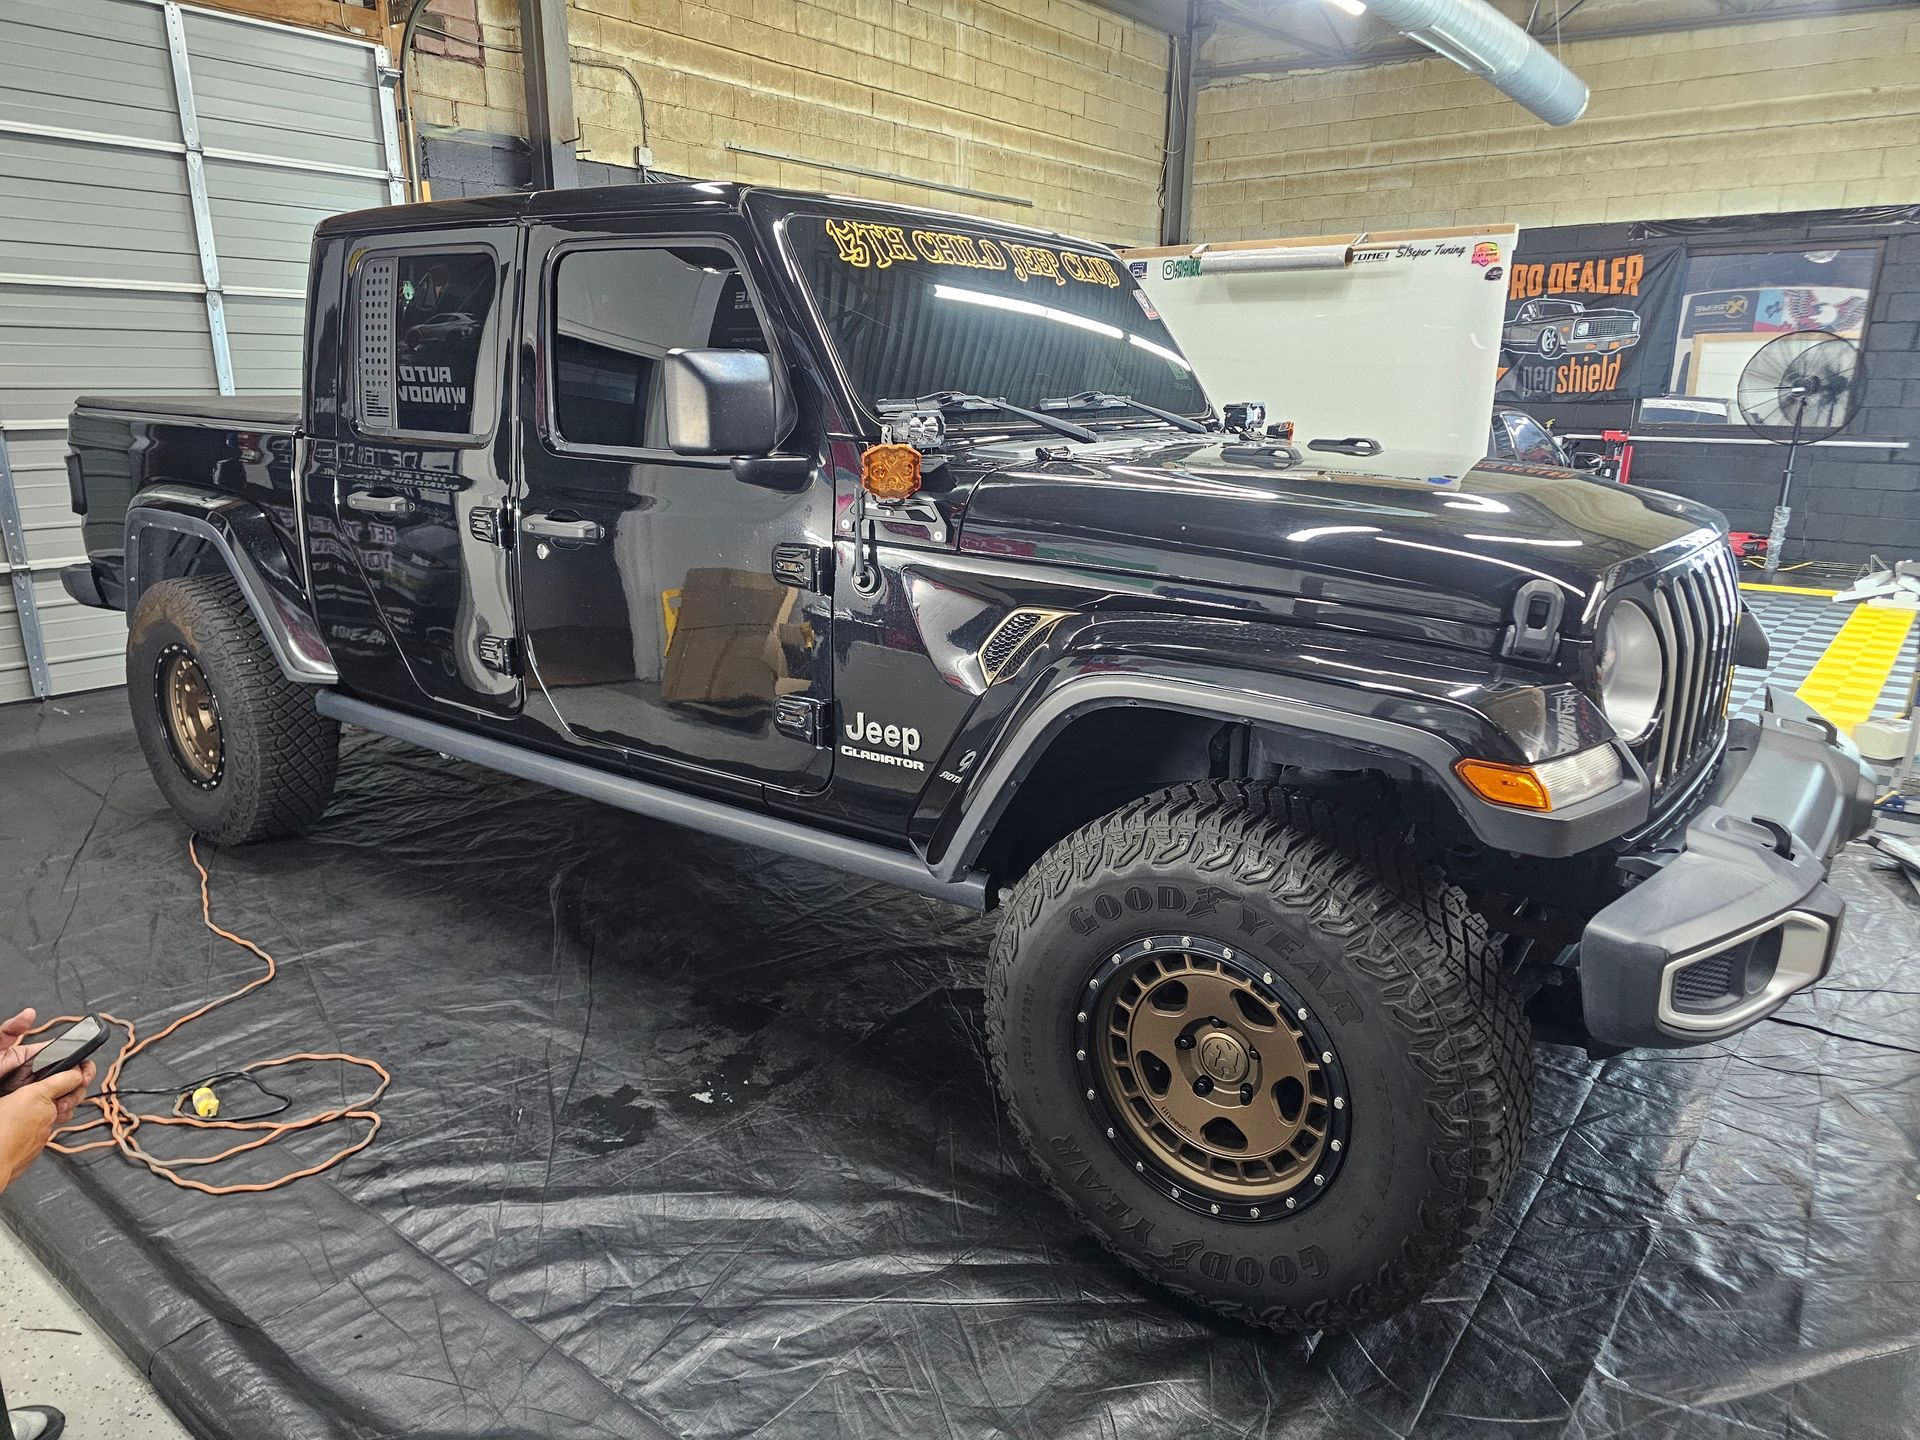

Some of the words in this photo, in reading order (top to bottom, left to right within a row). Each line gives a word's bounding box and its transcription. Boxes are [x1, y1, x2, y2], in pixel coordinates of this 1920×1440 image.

[912, 229, 1007, 270] CHILD
[1000, 240, 1066, 286] JEEP
[1060, 252, 1120, 288] CLUB
[1435, 243, 1466, 257] Tuning
[1508, 263, 1545, 300] RO
[1548, 254, 1644, 297] DEALER
[1521, 354, 1622, 397] geoshield
[845, 711, 922, 755] Jeep
[840, 745, 925, 772] GLADIATOR
